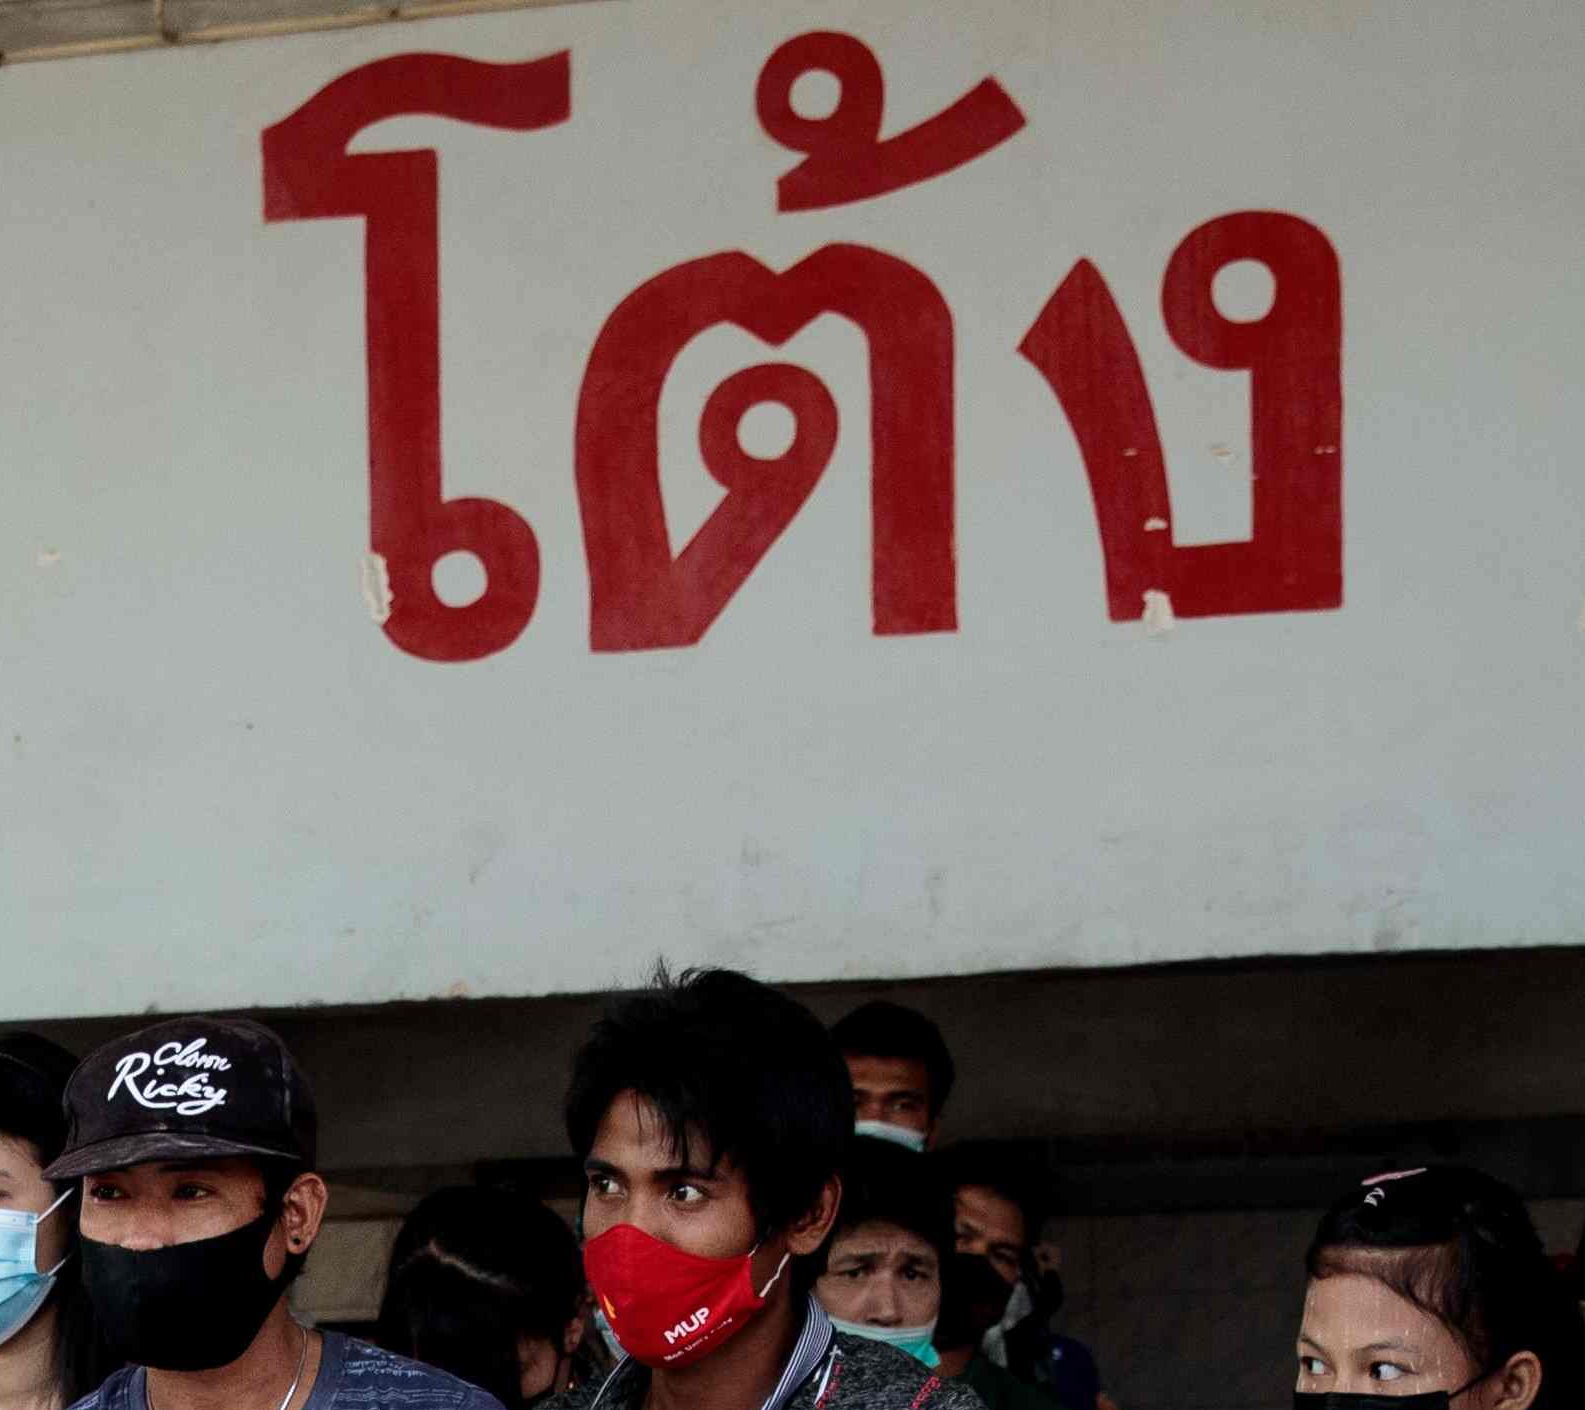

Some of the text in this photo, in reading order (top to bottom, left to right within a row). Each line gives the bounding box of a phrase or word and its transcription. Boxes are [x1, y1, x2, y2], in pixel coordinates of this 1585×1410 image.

[261, 30, 1342, 663] โต้ง
[108, 1052, 227, 1115] Ricky
[663, 1307, 710, 1344] MUP
